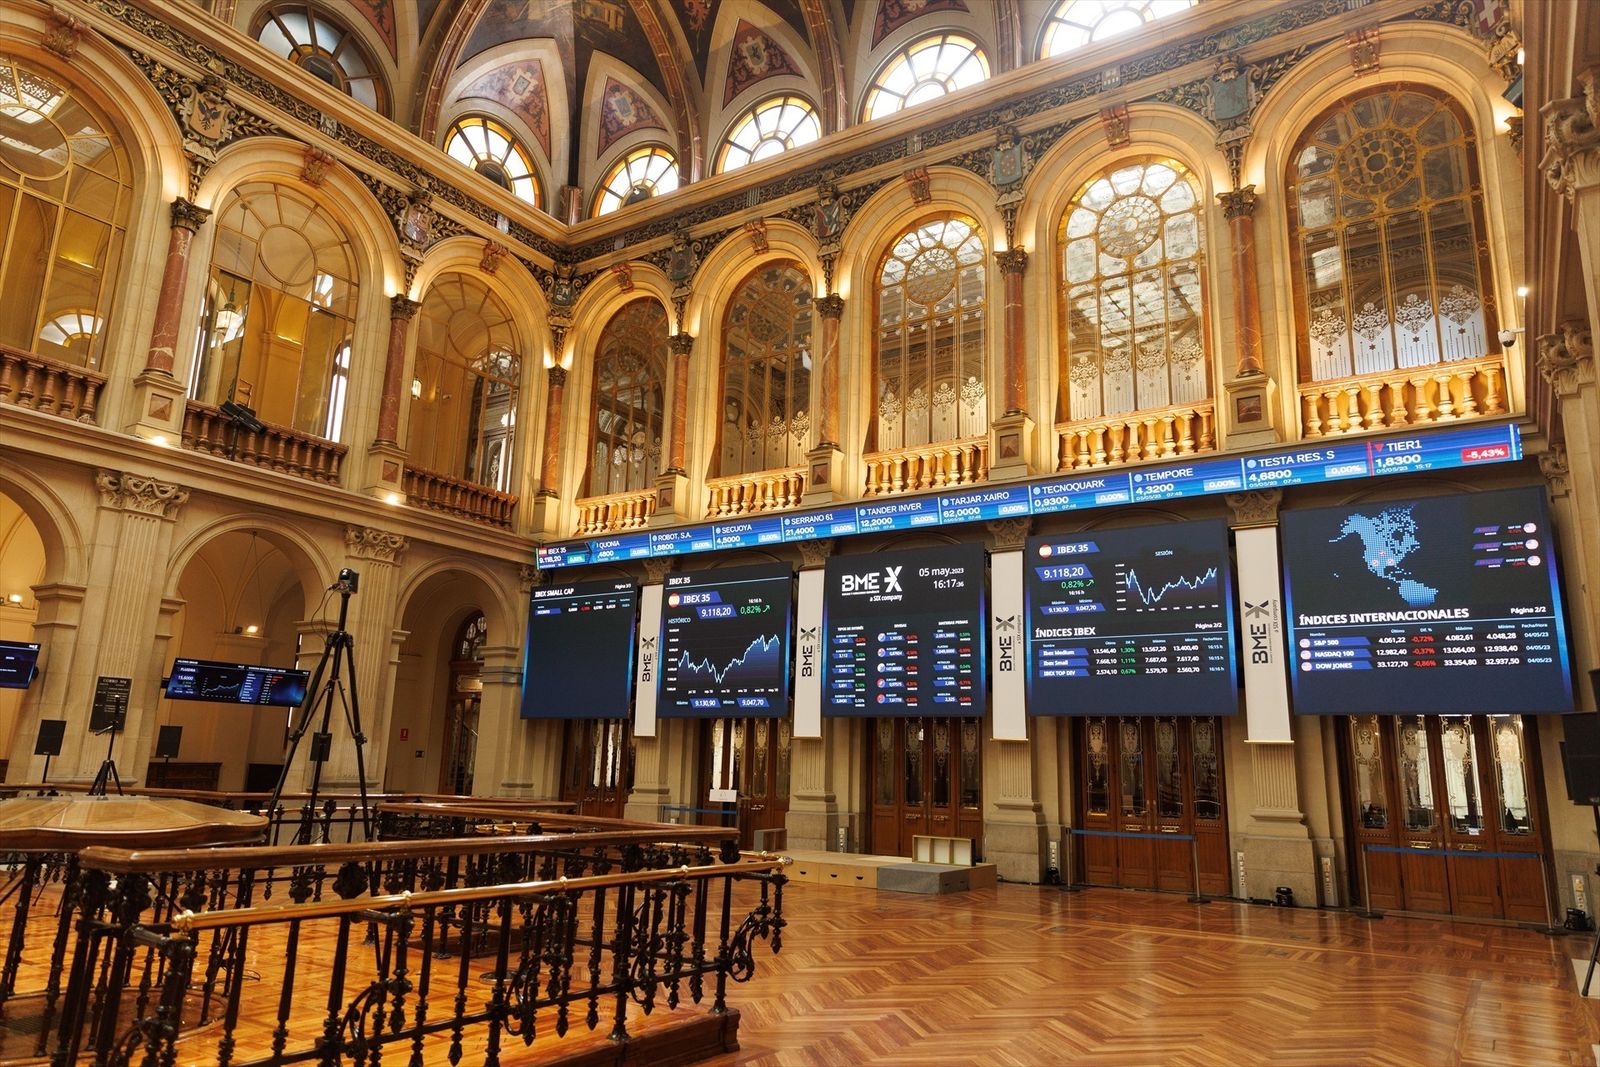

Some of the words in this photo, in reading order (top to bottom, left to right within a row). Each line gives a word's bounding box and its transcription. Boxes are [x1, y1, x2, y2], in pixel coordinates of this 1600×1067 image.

[1386, 440, 1422, 452] TIER1
[1258, 456, 1294, 468] TESTA
[1296, 452, 1324, 464] RES.
[1326, 450, 1335, 460] S
[1466, 448, 1504, 460] -5,43%
[1376, 454, 1422, 468] 1,8300
[1144, 468, 1193, 482] TEMPORE
[1249, 470, 1292, 482] 4,6800
[1042, 480, 1104, 494] TECNOQUARK
[1136, 484, 1174, 496] 4,3200
[950, 496, 982, 506] TARJAR
[984, 492, 1010, 502] XAIRO
[1034, 496, 1069, 507] 0,9300
[867, 506, 896, 516] TANDER
[899, 502, 922, 512] INVER
[943, 507, 980, 518] 62,0000
[791, 515, 824, 524] SERRANO
[860, 517, 892, 527] 12,2000
[722, 525, 752, 534] SECUOYA
[785, 527, 814, 536] 21,4000
[1057, 546, 1076, 554] IBEX
[919, 568, 930, 577] 05
[1044, 567, 1084, 579] 9.118,20
[842, 572, 880, 591] BME
[1061, 580, 1084, 589] 0,82%
[683, 595, 700, 603] IBEX
[702, 607, 731, 617] 9.118,20
[740, 605, 761, 614] 0,82%
[1299, 614, 1347, 625] ÍNDICES
[1350, 608, 1470, 623] INTERNACIONALES
[1036, 628, 1072, 638] ÍNDICES
[1074, 627, 1096, 636] IBEX
[1250, 624, 1268, 664] BME
[999, 636, 1012, 671] BME
[802, 645, 812, 676] BME
[642, 653, 651, 682] BME
